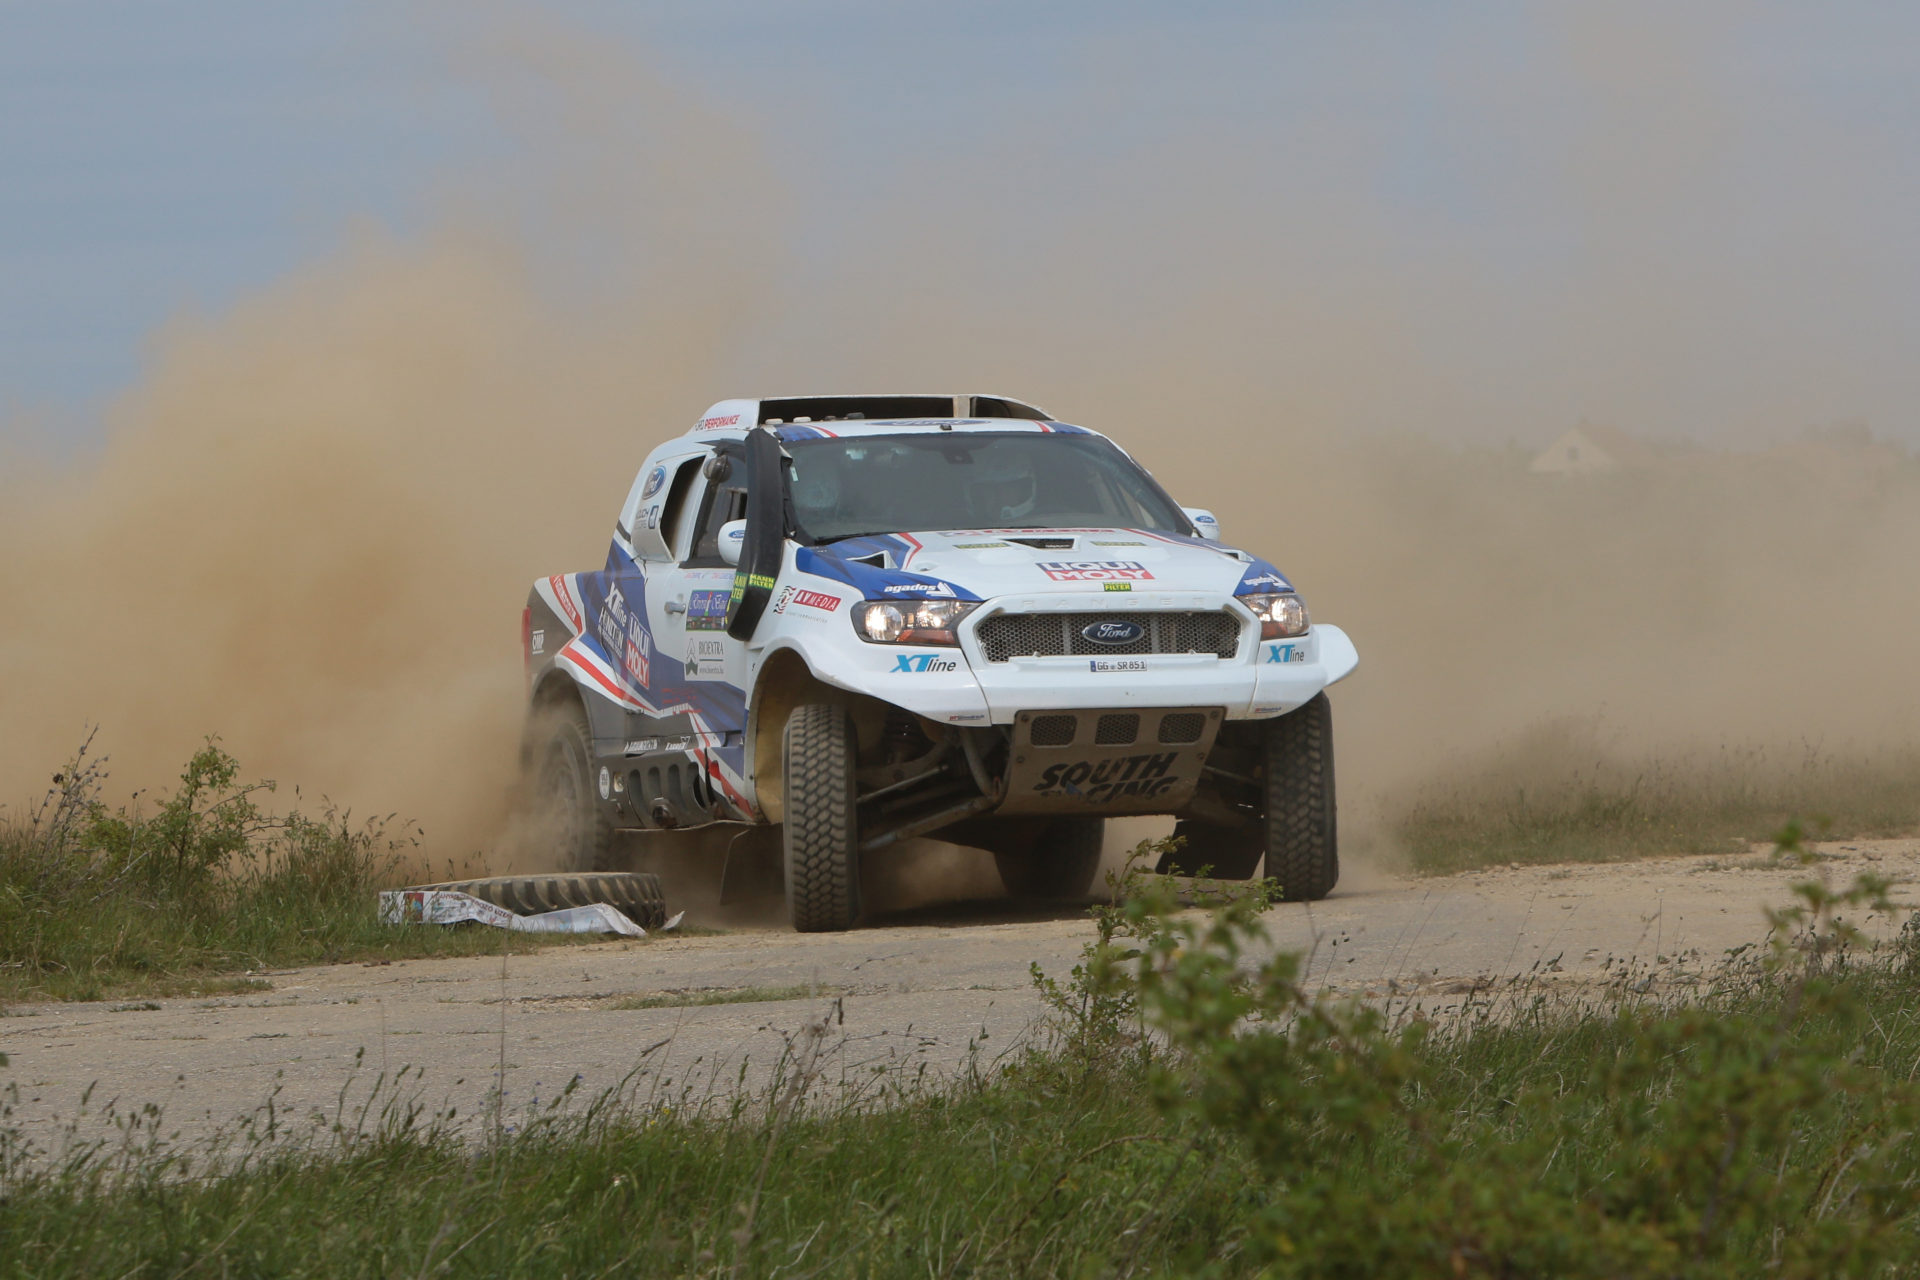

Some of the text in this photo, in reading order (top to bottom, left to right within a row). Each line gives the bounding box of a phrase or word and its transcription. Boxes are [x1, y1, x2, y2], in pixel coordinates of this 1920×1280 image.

[705, 414, 741, 429] PERFORMANCE
[1041, 561, 1140, 571] LIQUI
[750, 573, 775, 583] MANN
[1050, 570, 1146, 580] MOLY
[749, 579, 774, 590] FILTER
[883, 583, 937, 594] agados
[1104, 582, 1131, 591] FILTER
[1096, 623, 1132, 638] Ford
[629, 616, 652, 660] LIQUI
[1266, 644, 1305, 664] XTline
[627, 642, 650, 684] MOLY
[889, 654, 957, 673] XTline
[1097, 661, 1109, 671] GG
[1033, 751, 1179, 791] SOUTH
